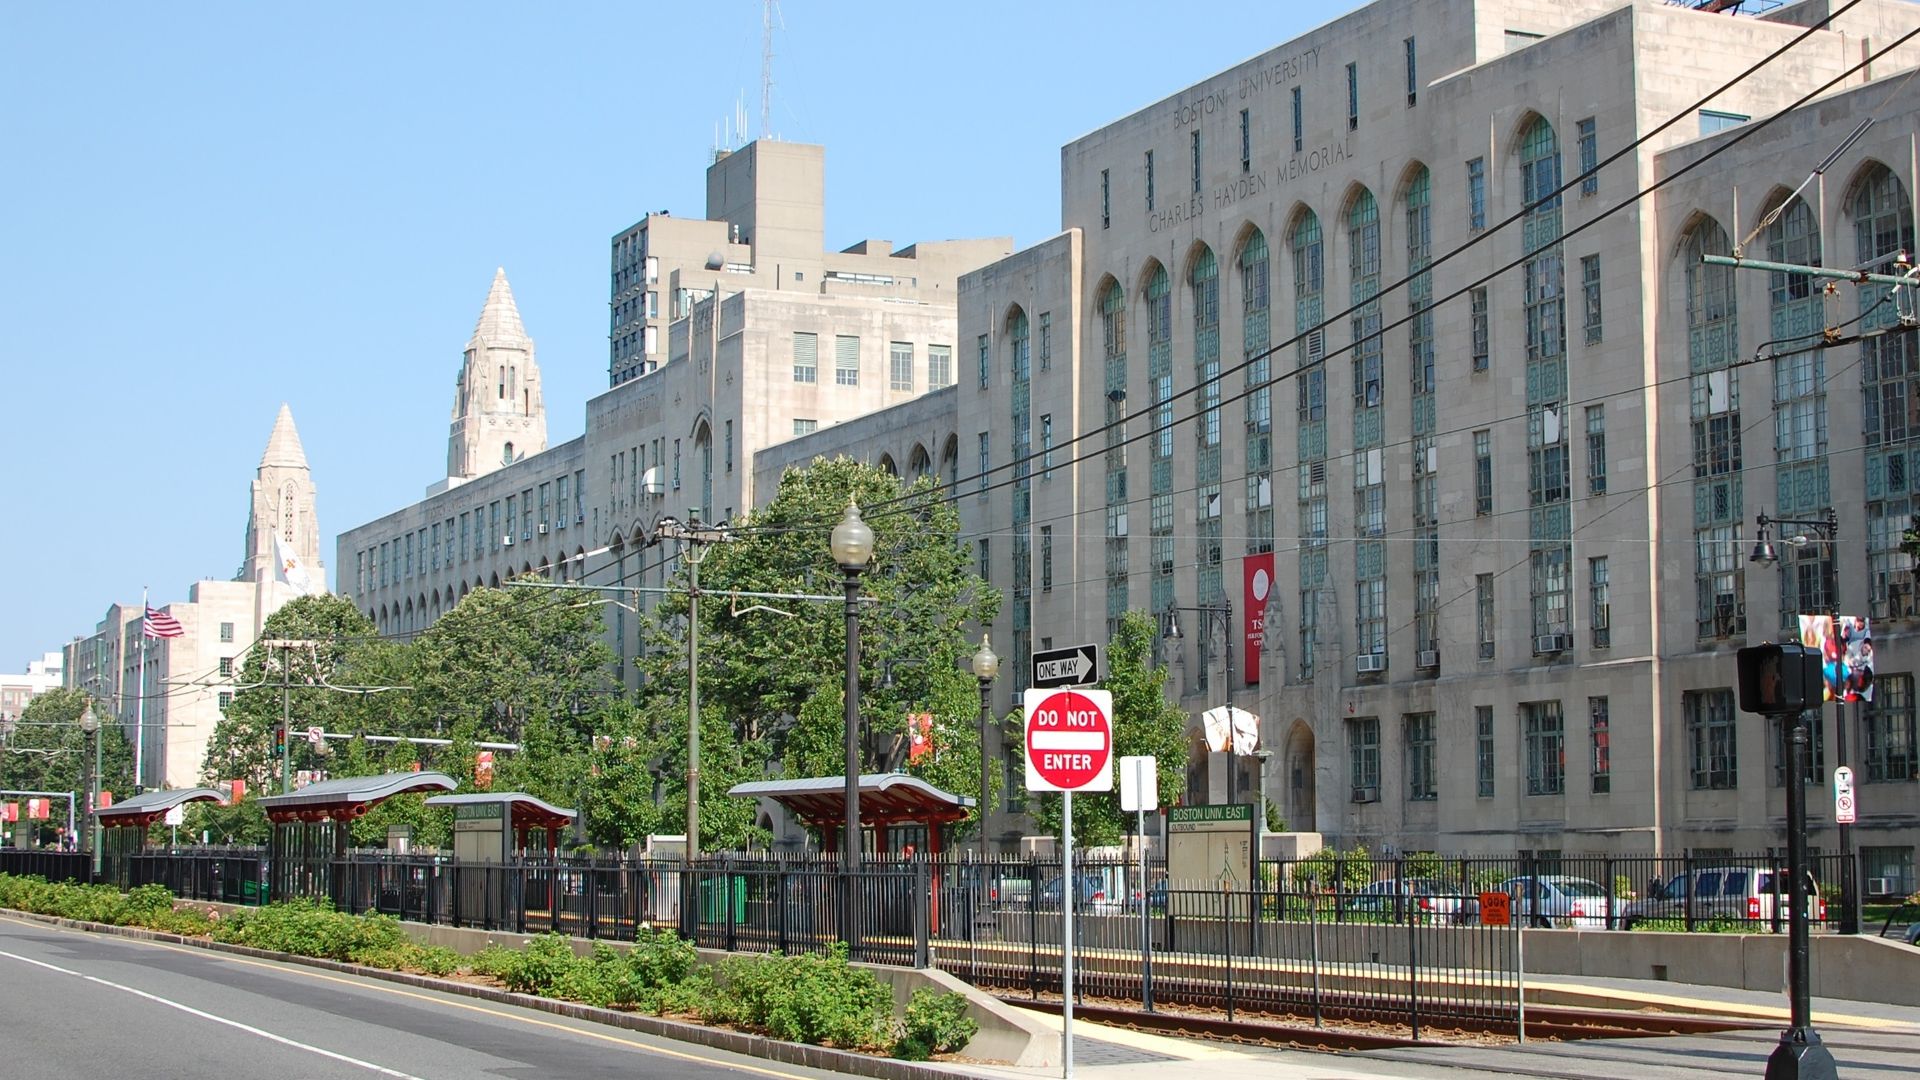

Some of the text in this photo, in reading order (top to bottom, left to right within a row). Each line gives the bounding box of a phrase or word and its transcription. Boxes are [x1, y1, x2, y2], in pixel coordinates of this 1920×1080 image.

[1173, 46, 1321, 130] BOSTON UNIVERSITY
[1149, 143, 1353, 233] CHARLES HAYDEN MEMORIAL
[1252, 619, 1264, 630] TS
[1038, 658, 1078, 679] ONE WAY
[1038, 710, 1097, 727] DO NOT
[1043, 754, 1092, 770] ENTER
[1173, 806, 1245, 821] BOSTON UNIV. EAST
[1171, 823, 1196, 831] OUTBOUND
[1482, 898, 1506, 908] LOOK
